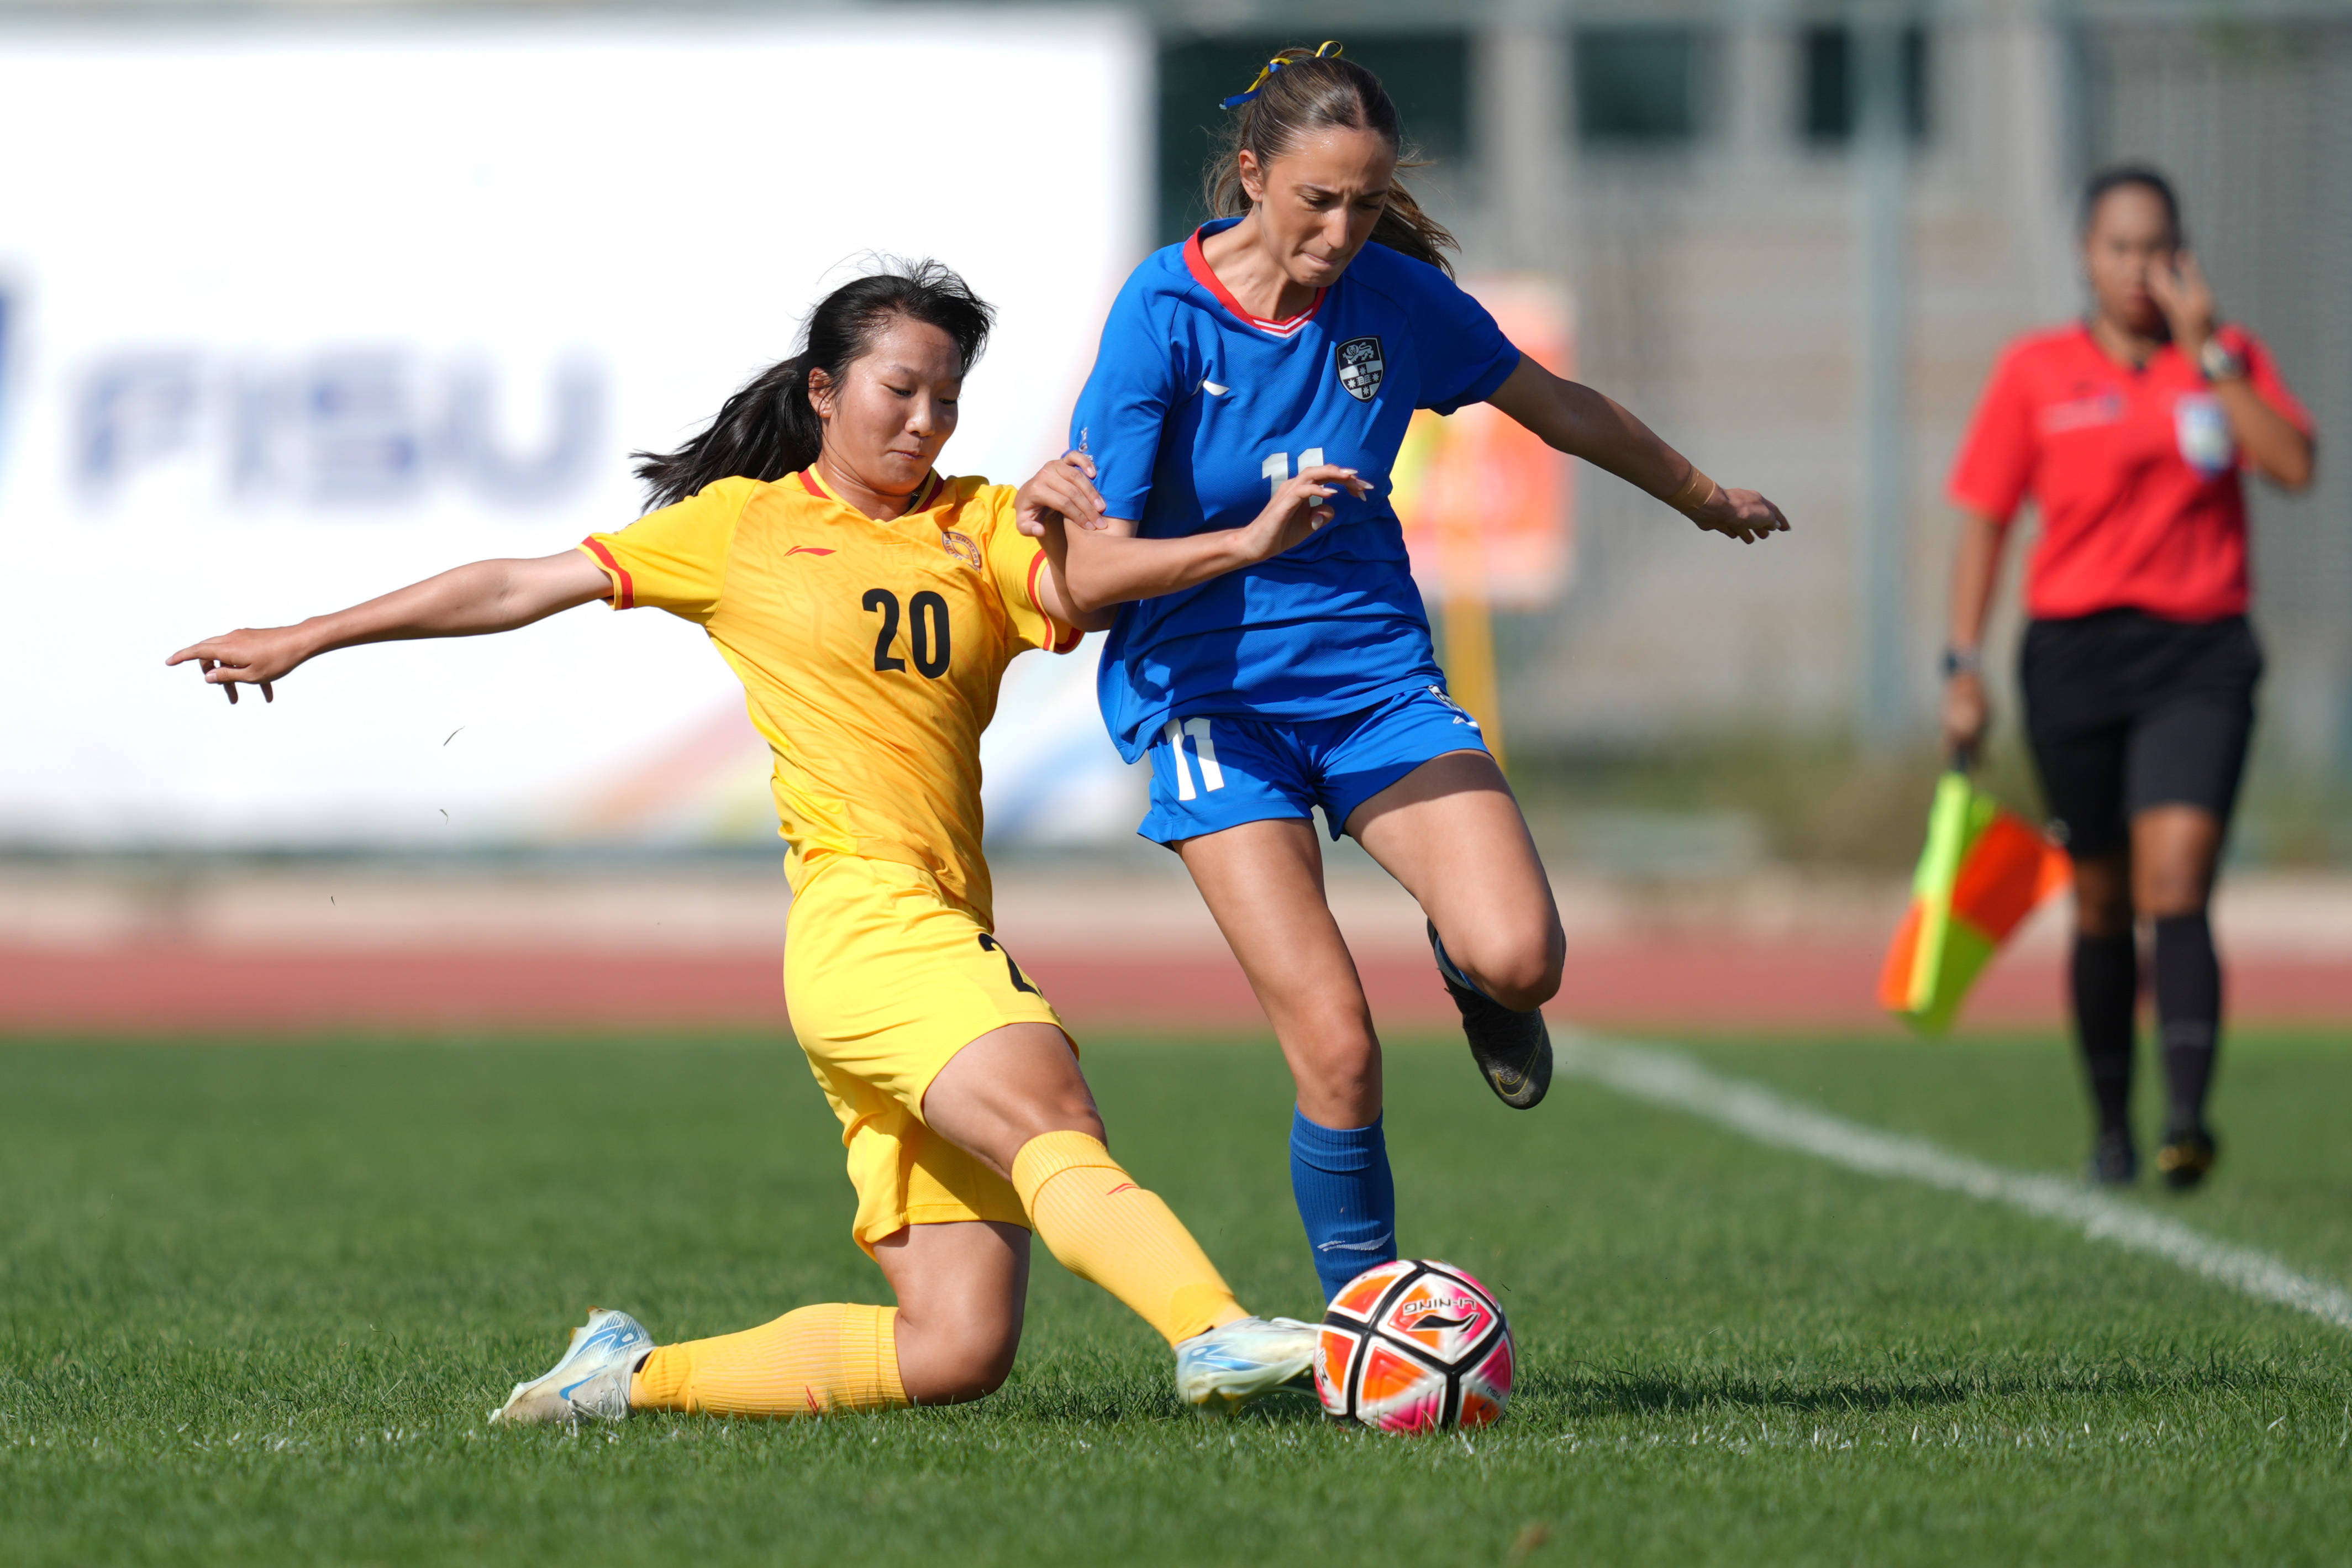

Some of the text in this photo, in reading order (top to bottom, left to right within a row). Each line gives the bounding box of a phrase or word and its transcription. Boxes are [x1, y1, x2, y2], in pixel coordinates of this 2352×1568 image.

[1261, 448, 1324, 507] 11
[861, 588, 951, 679] 20
[1164, 717, 1224, 801] 11
[978, 933, 1043, 999] 2
[1404, 1298, 1476, 1313] LI-NING
